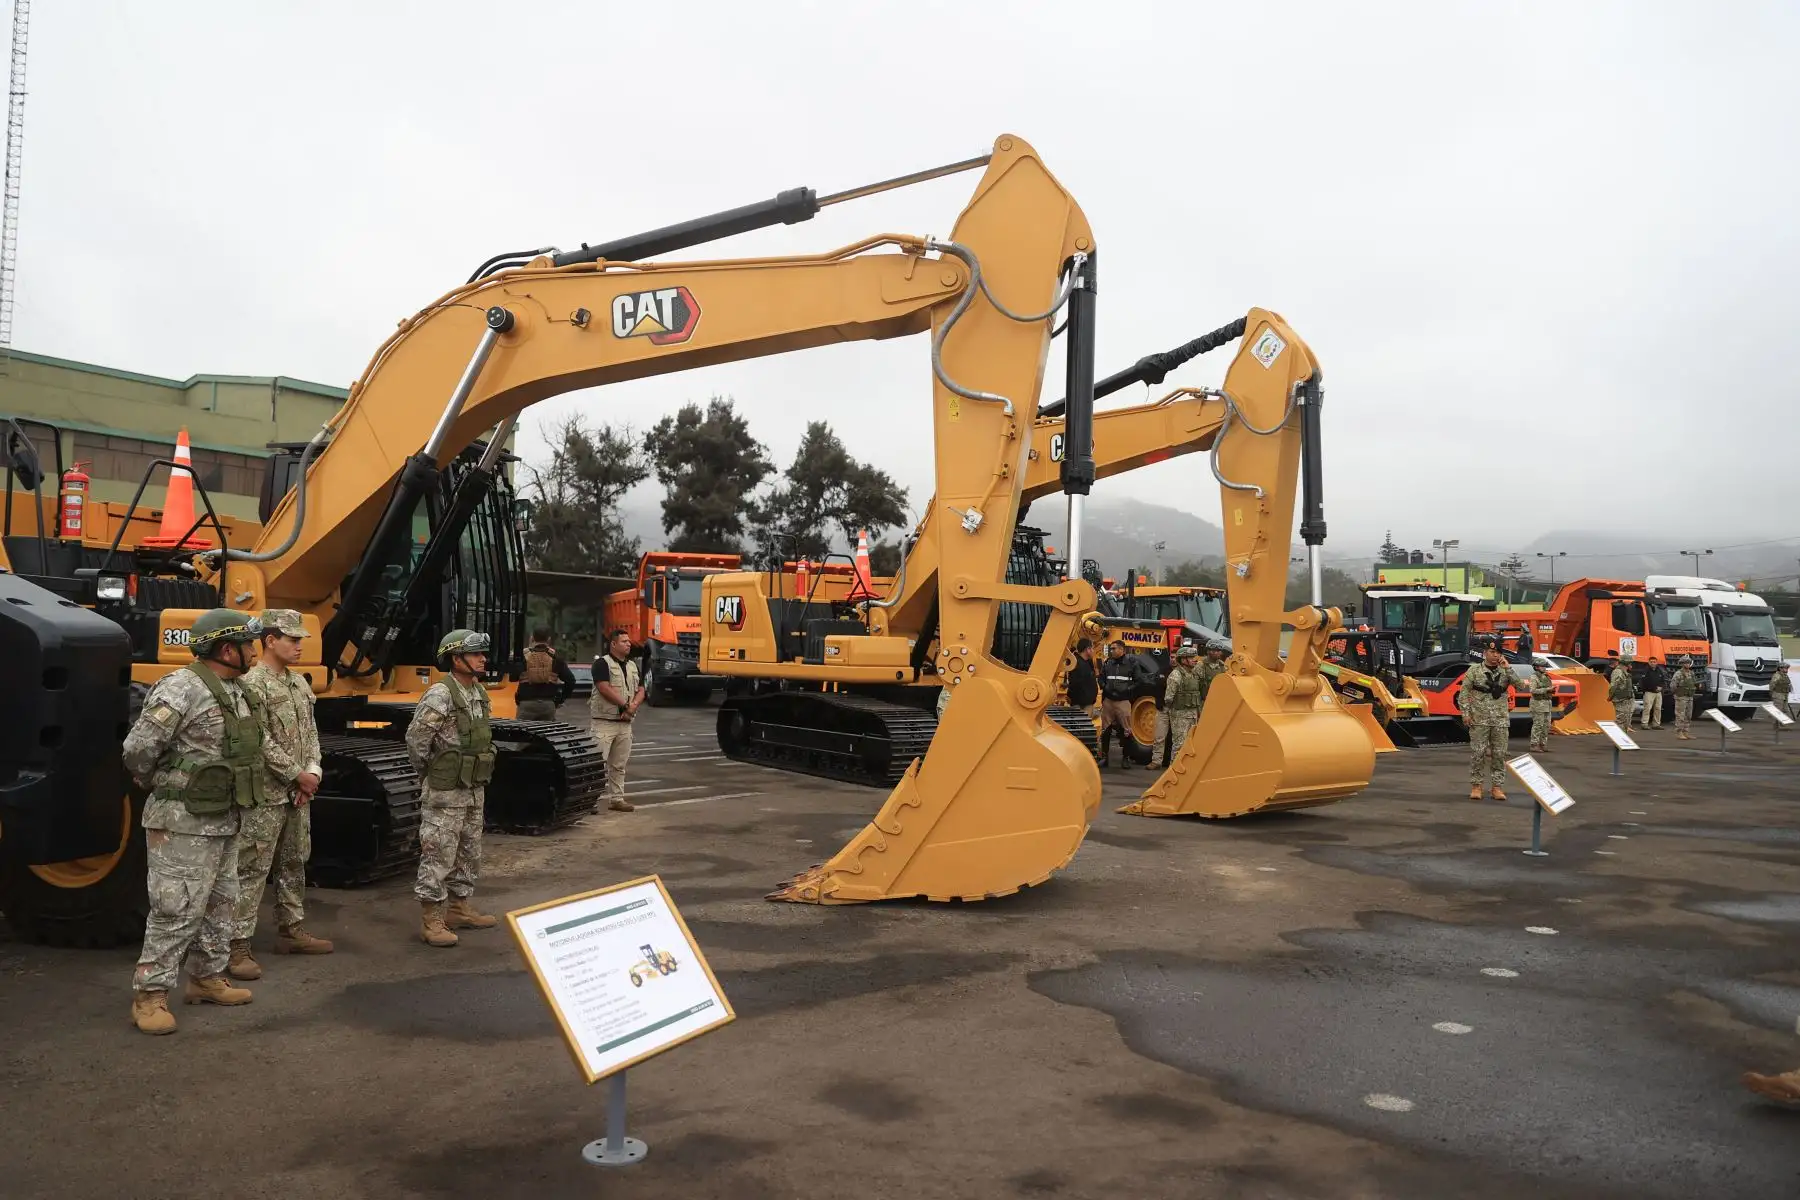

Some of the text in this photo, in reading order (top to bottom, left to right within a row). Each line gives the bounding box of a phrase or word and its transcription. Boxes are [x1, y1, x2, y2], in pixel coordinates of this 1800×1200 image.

[613, 289, 678, 337] CAT
[716, 597, 740, 623] CAT
[164, 629, 191, 645] 330
